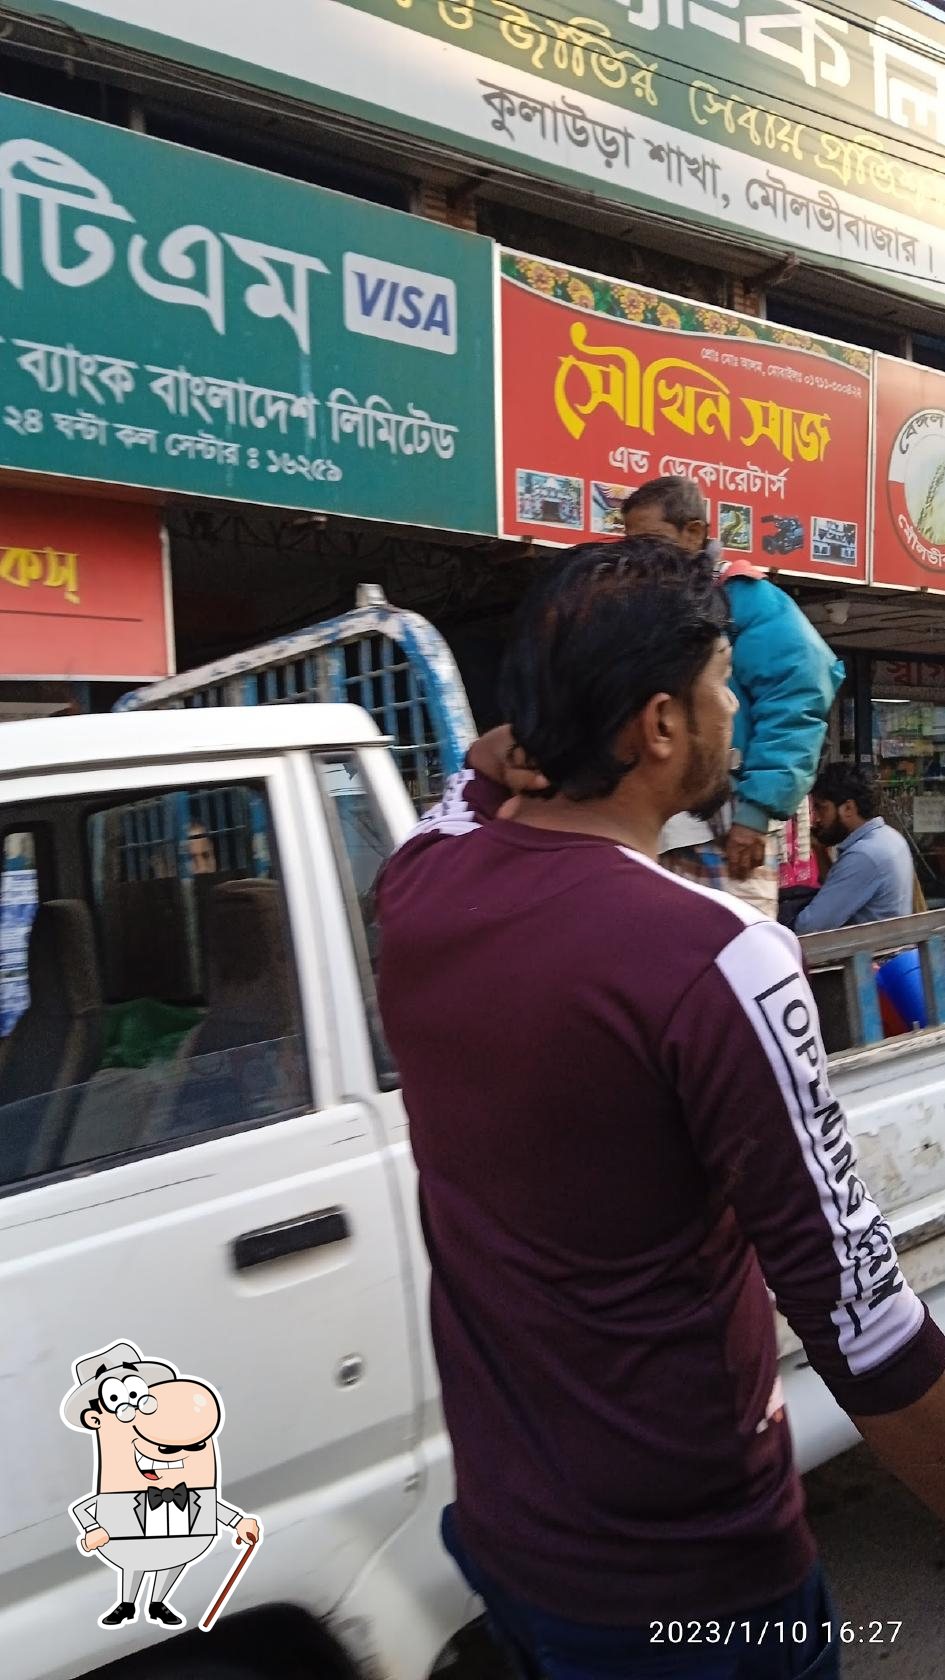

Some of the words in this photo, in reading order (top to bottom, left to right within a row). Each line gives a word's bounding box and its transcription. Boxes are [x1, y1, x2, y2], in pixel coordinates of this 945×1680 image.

[477, 78, 635, 169] কুলাউড়া
[350, 270, 452, 337] VISA
[4, 405, 44, 436] ২৪
[112, 423, 160, 453] কল
[10, 338, 140, 405] ব্যাংক
[144, 364, 321, 440] বাংলাদেশ
[326, 388, 458, 460] লিমিটেড
[554, 322, 731, 440] সৌখিন
[740, 397, 832, 462] সাজ
